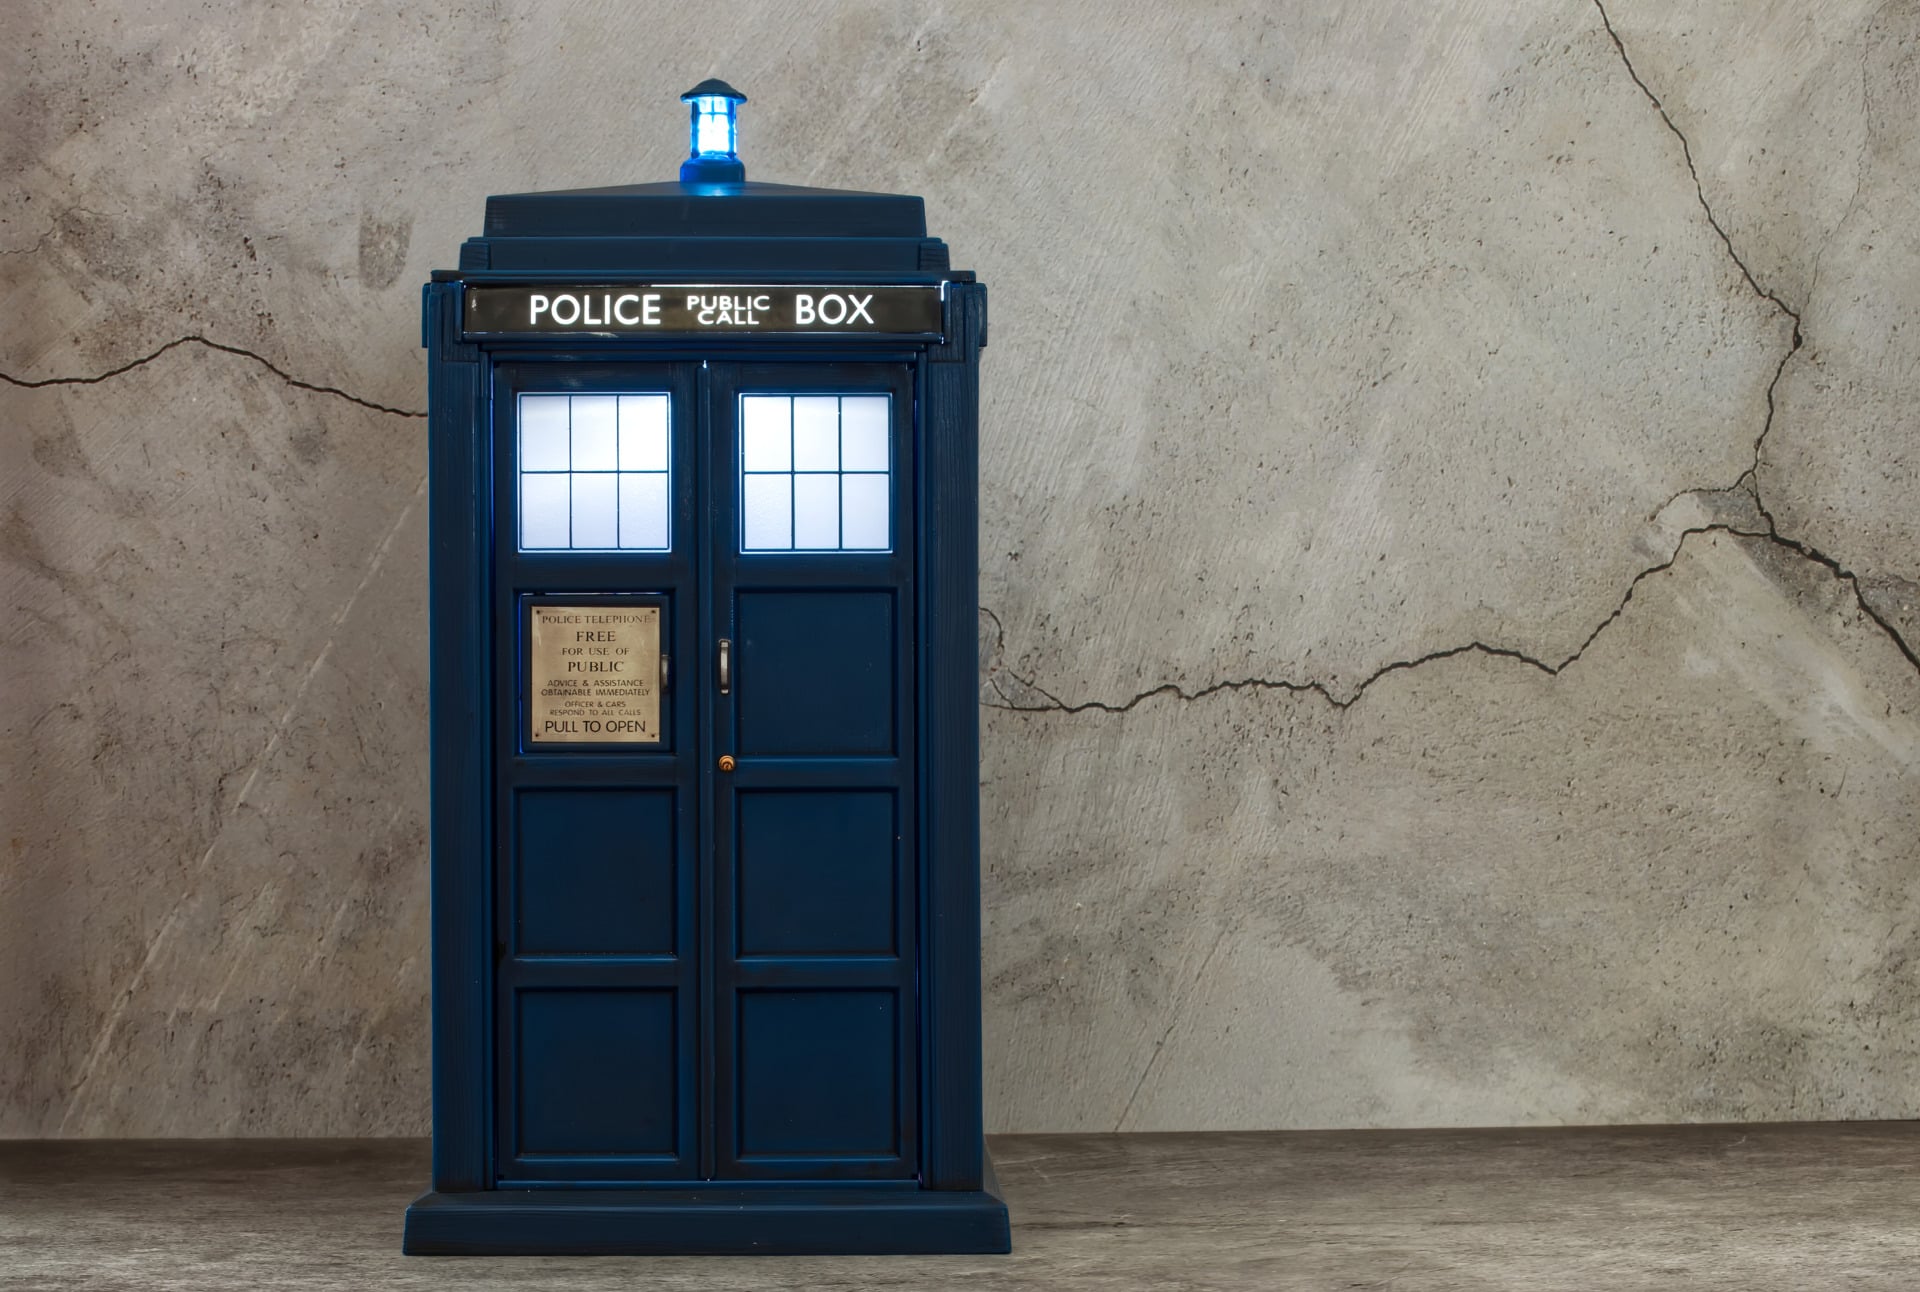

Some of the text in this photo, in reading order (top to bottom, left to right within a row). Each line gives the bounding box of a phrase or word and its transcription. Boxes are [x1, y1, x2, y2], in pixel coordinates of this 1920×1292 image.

[530, 294, 874, 325] POLICE PUBLIC CALL BOX
[542, 616, 581, 624] POLICE
[576, 631, 616, 642] FREE
[562, 647, 630, 655] FOR USE OF
[568, 661, 625, 672] PUBLIC
[545, 720, 646, 733] PULL TO OPEN
